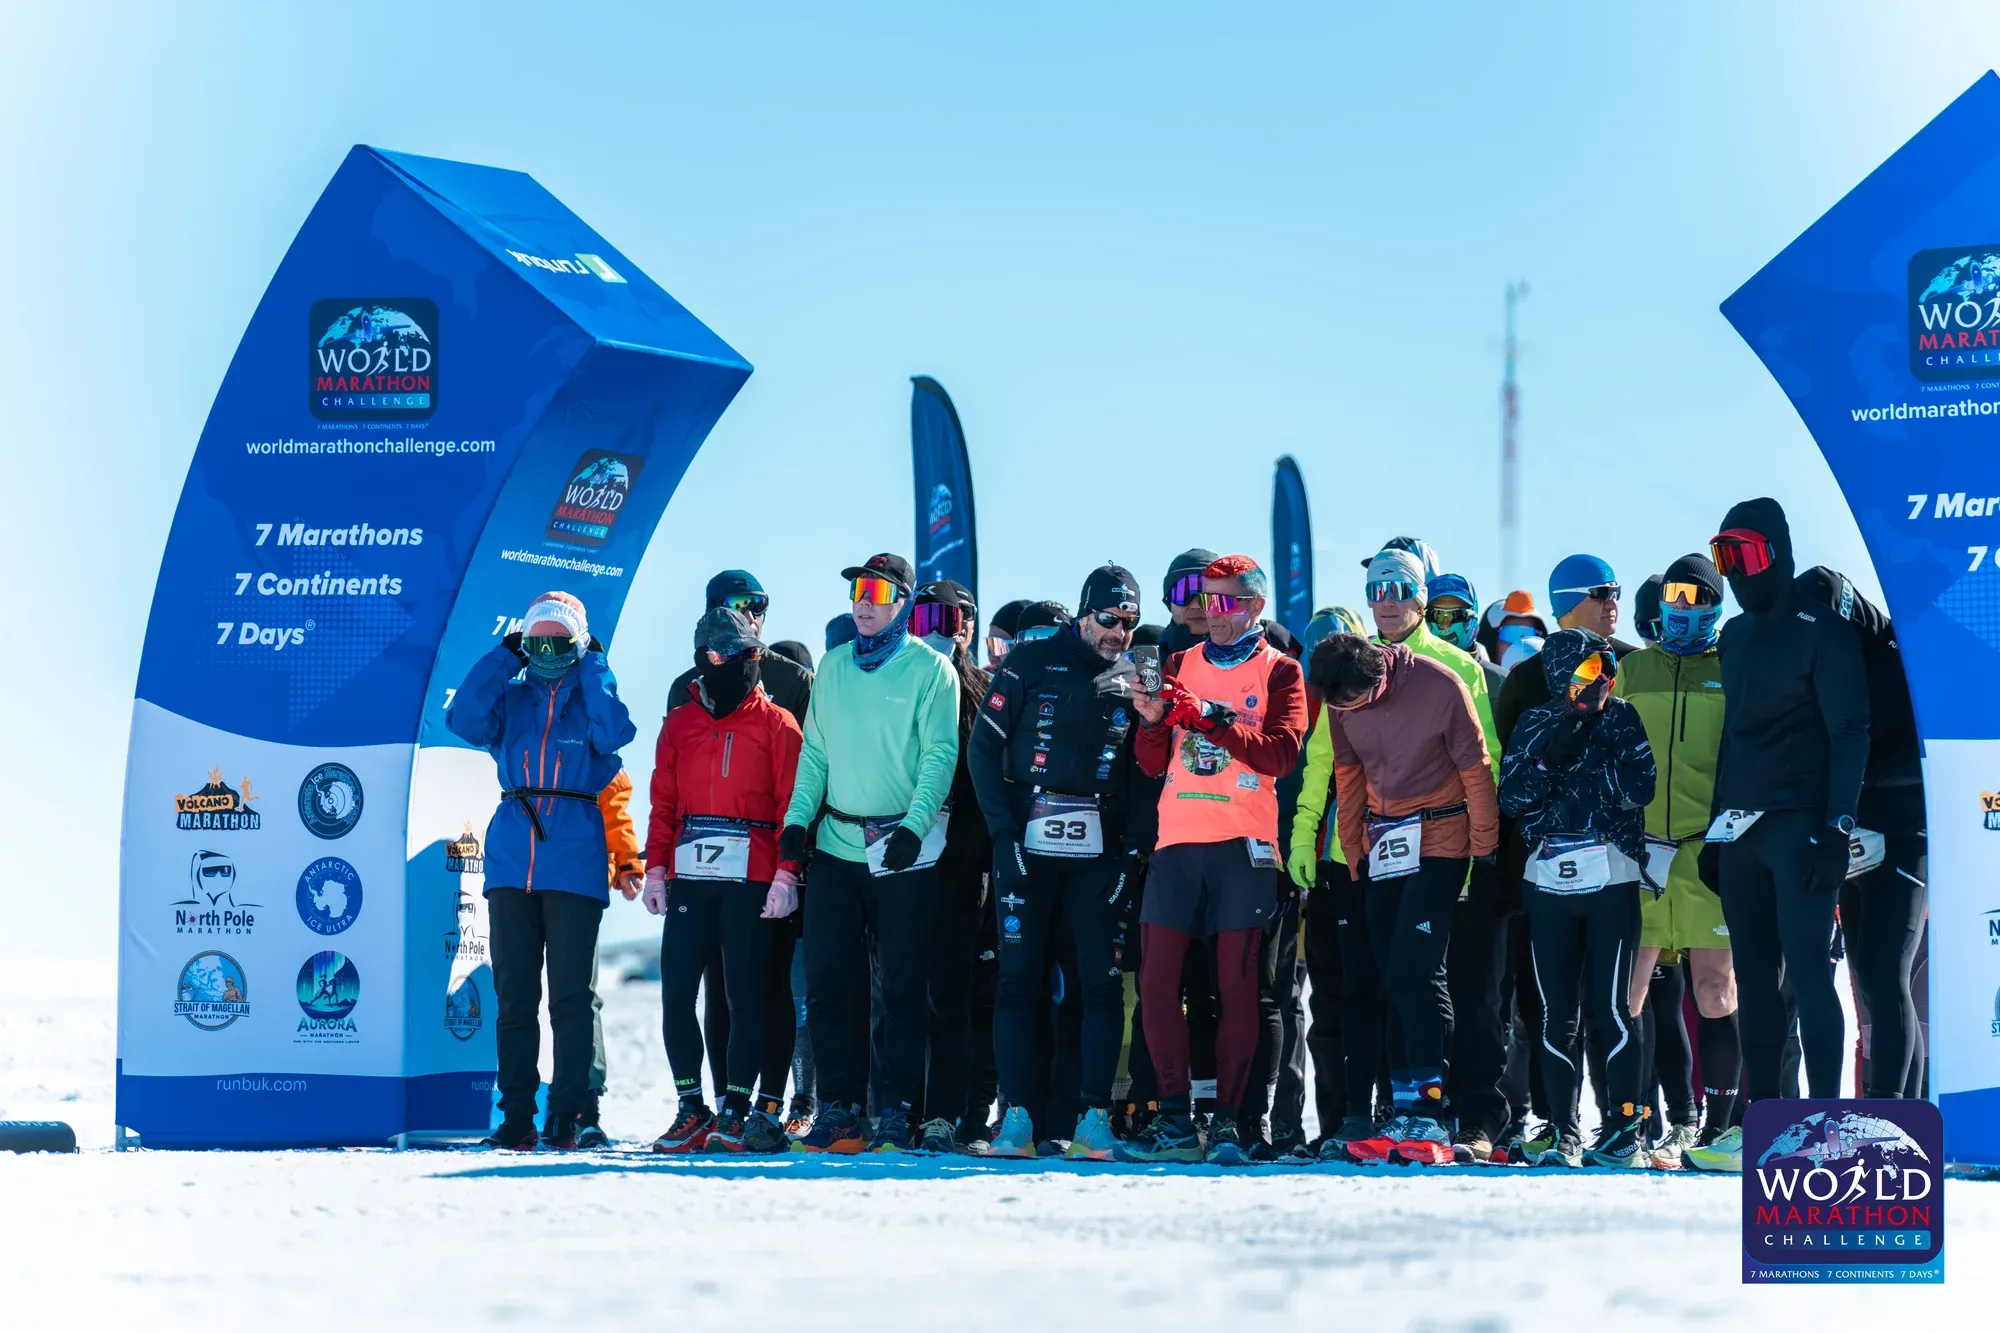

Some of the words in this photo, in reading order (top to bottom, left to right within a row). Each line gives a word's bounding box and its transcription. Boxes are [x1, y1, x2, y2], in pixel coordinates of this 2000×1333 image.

[317, 345, 431, 375] WORLD
[1926, 352, 2000, 366] CHALL
[317, 375, 430, 391] MARATHON
[1926, 384, 1970, 392] MARATHONS
[322, 396, 424, 406] CHALLENGE
[246, 437, 496, 457] worldmarathonchallenge.com
[565, 484, 623, 511] WORLD
[1907, 494, 1928, 519] 7
[1934, 492, 2000, 518] Mar
[555, 504, 615, 525] MARATHON
[255, 523, 273, 546] 7
[277, 523, 423, 546] Marathons
[553, 521, 604, 536] CHALLENGE
[501, 549, 623, 577] worldmarathonchallenge.com
[1967, 546, 1988, 571] 7
[235, 572, 252, 595] 7
[257, 570, 402, 595] Continents
[217, 622, 234, 645] 7
[492, 616, 507, 635] 7
[1035, 755, 1045, 763] tio
[177, 797, 229, 810] VOLCANO
[180, 813, 260, 829] MARATHON
[1044, 819, 1087, 840] 33
[447, 845, 474, 855] VOLCANO
[694, 843, 725, 864] 17
[1378, 836, 1410, 861] 25
[1013, 841, 1028, 876] SALOMON
[304, 861, 354, 883] ANTARCTIC
[1558, 860, 1578, 879] 6
[1108, 872, 1126, 905] SALOMON
[224, 910, 254, 927] Pole
[307, 916, 322, 931] ICE
[326, 914, 353, 932] ULTRA
[469, 941, 484, 955] Pole
[174, 1002, 199, 1013] STRAIT
[201, 1002, 210, 1012] OF
[211, 1003, 250, 1015] MAGELLAN
[297, 1017, 357, 1032] AURORA
[217, 1077, 307, 1091] runbuk.com
